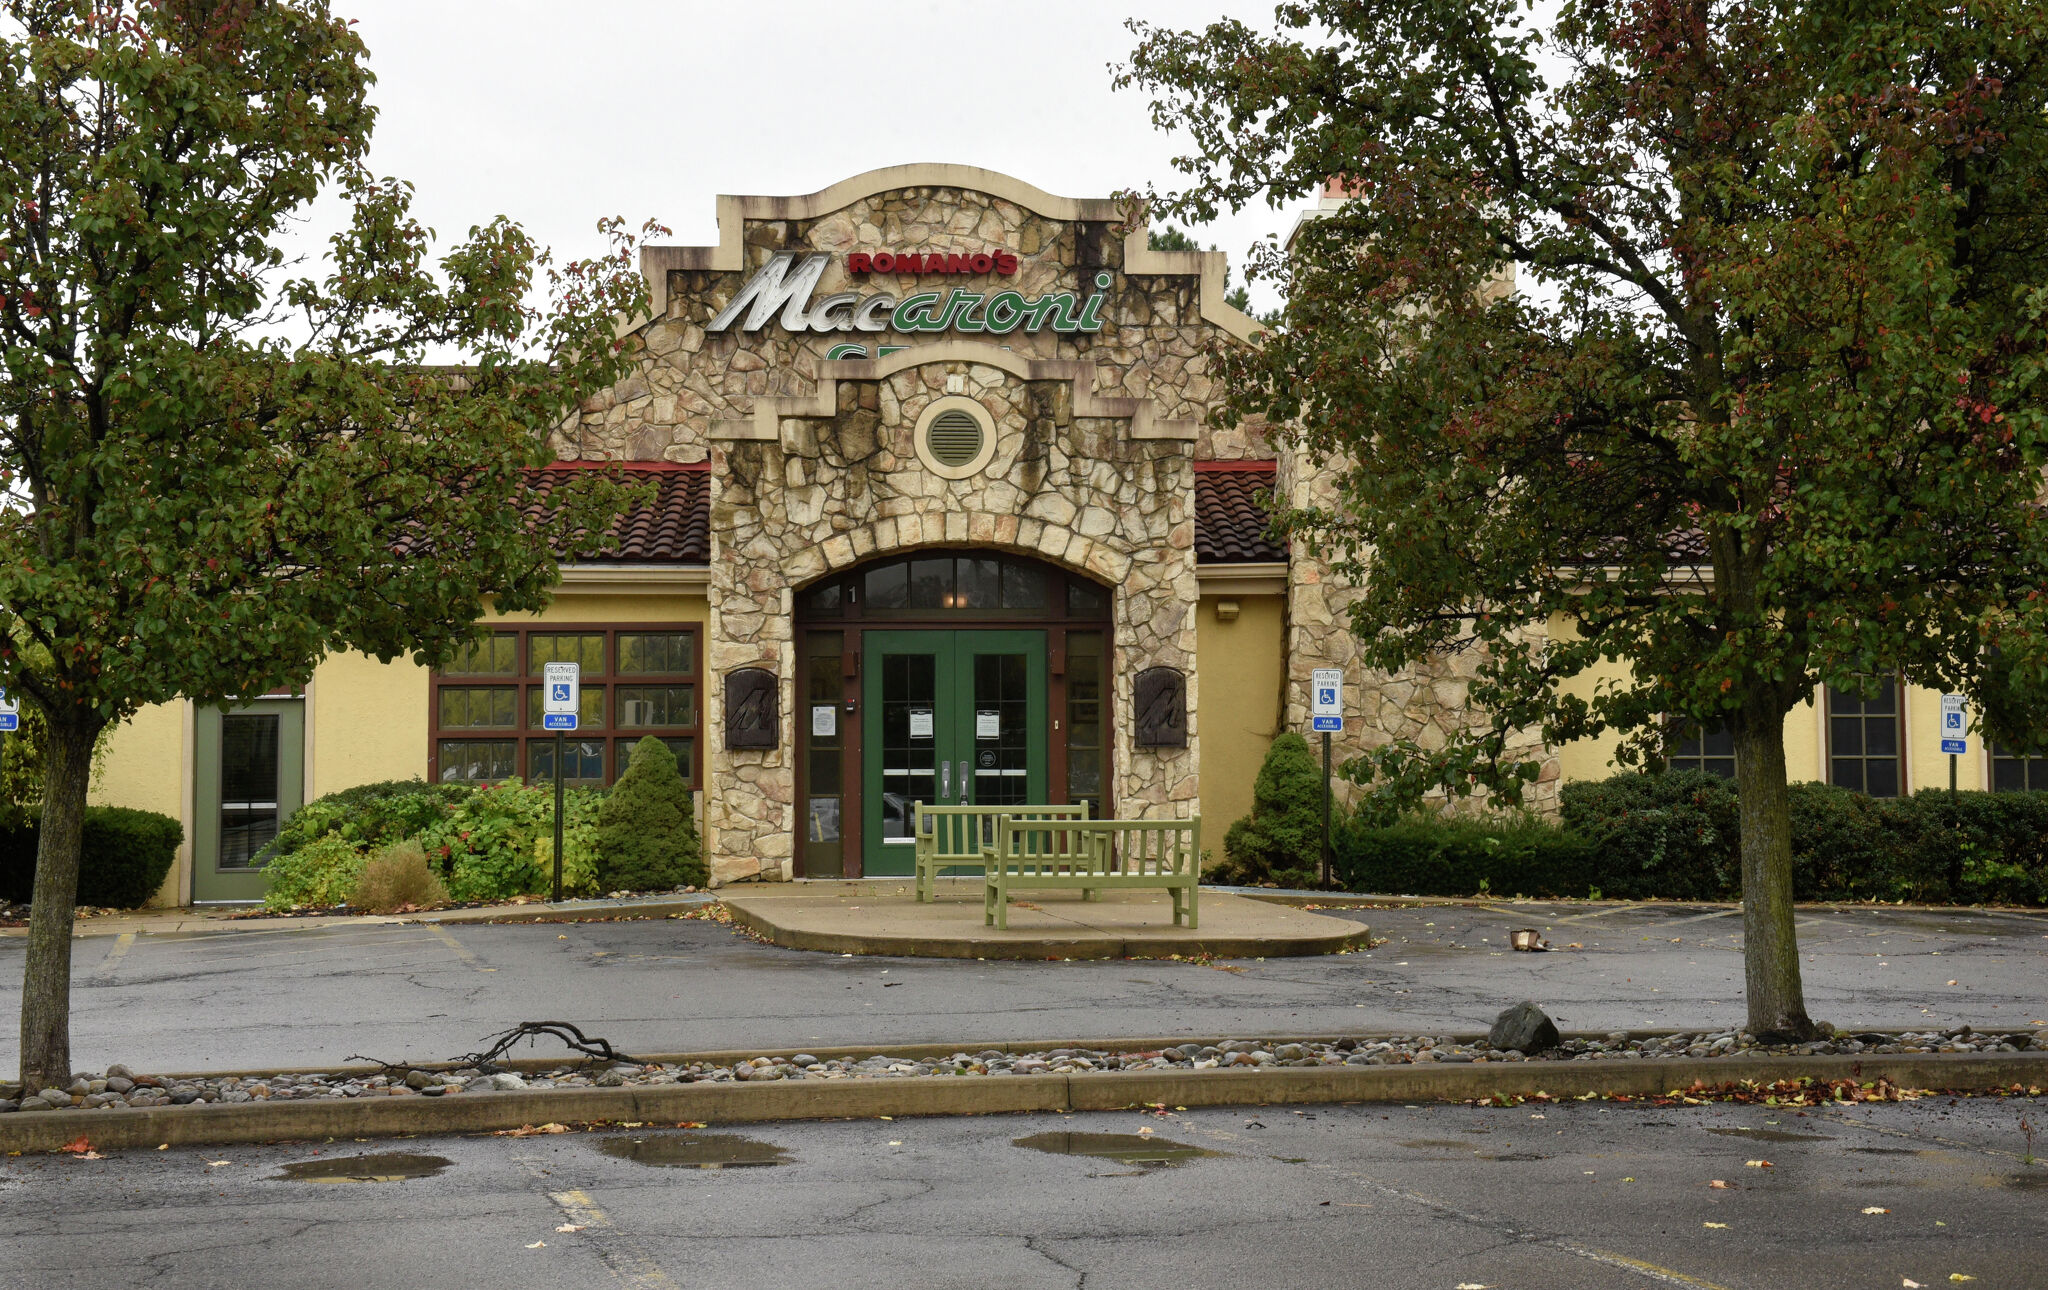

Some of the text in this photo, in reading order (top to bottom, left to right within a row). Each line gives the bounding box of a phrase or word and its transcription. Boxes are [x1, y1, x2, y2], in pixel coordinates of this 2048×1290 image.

[849, 250, 1018, 275] ROMANO'S
[704, 250, 1112, 333] Macaroni
[848, 585, 856, 602] 1
[547, 666, 576, 674] RESERVED
[1315, 672, 1339, 680] RESERVED
